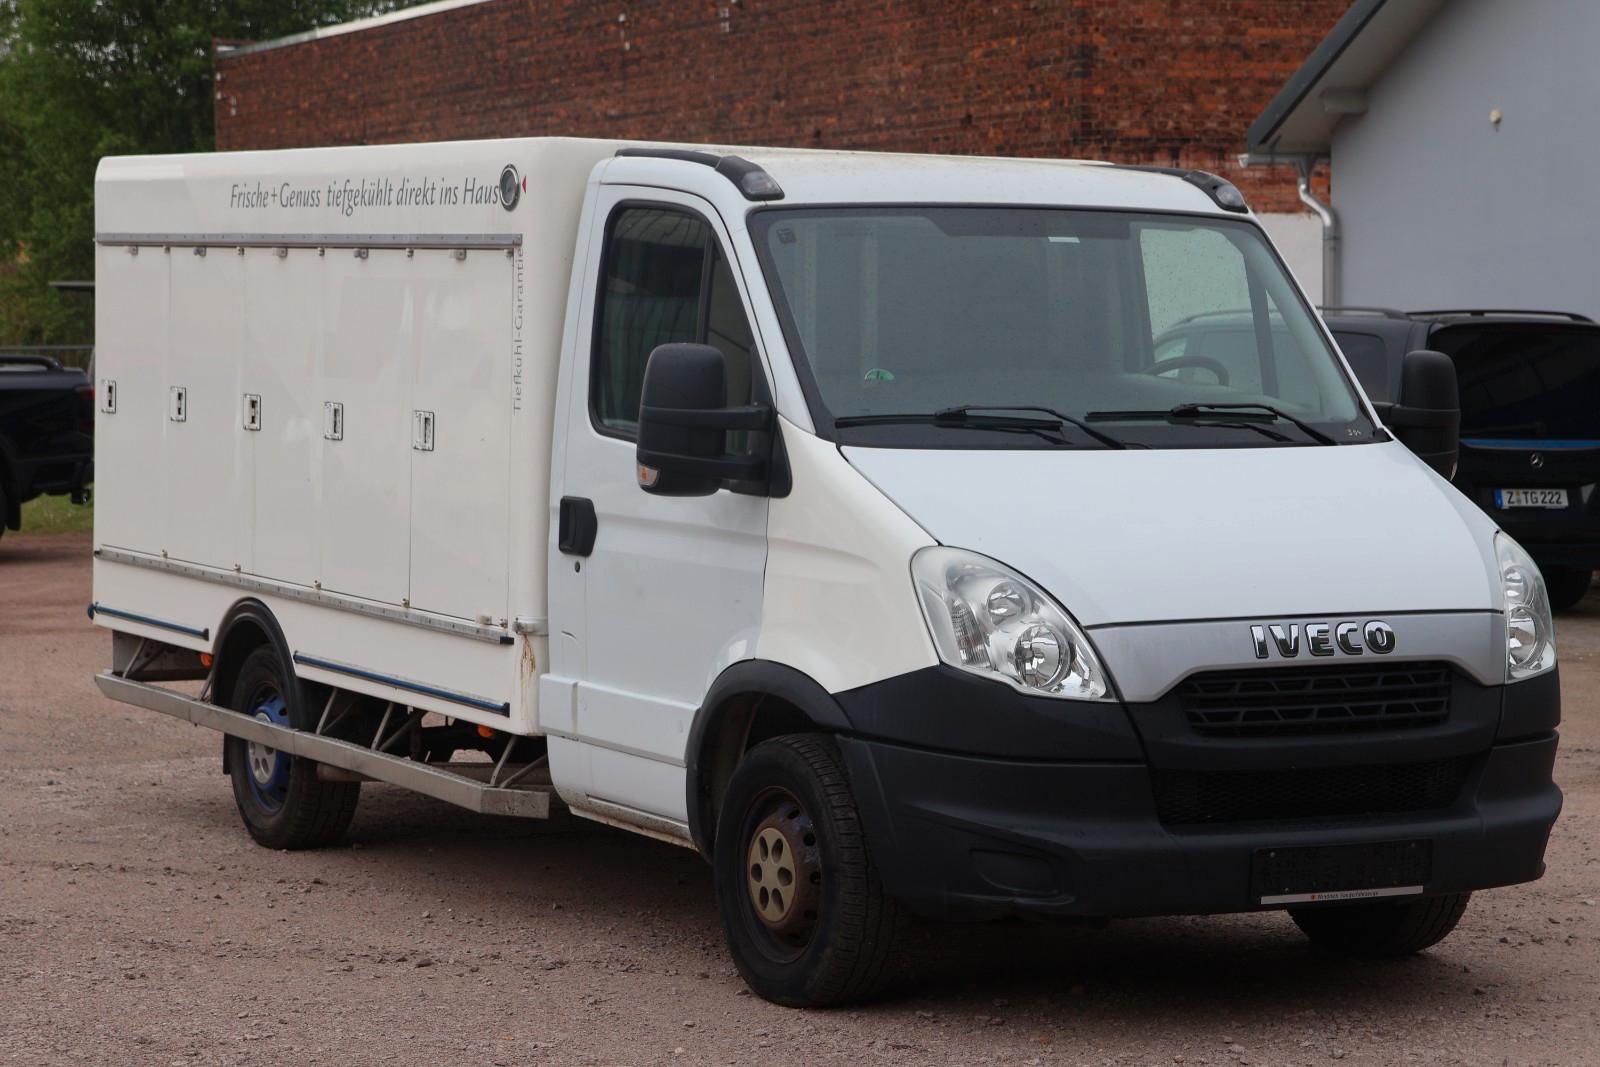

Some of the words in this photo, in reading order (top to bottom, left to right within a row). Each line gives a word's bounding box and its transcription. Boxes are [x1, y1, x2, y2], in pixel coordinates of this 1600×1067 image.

[327, 178, 393, 217] tiefgekühlt
[396, 176, 436, 207] direkt
[439, 177, 459, 206] ins
[463, 176, 499, 205] Haus
[1506, 491, 1515, 505] Z
[1523, 491, 1538, 505] TG
[1540, 491, 1562, 505] 222
[1250, 620, 1396, 659] IVECO
